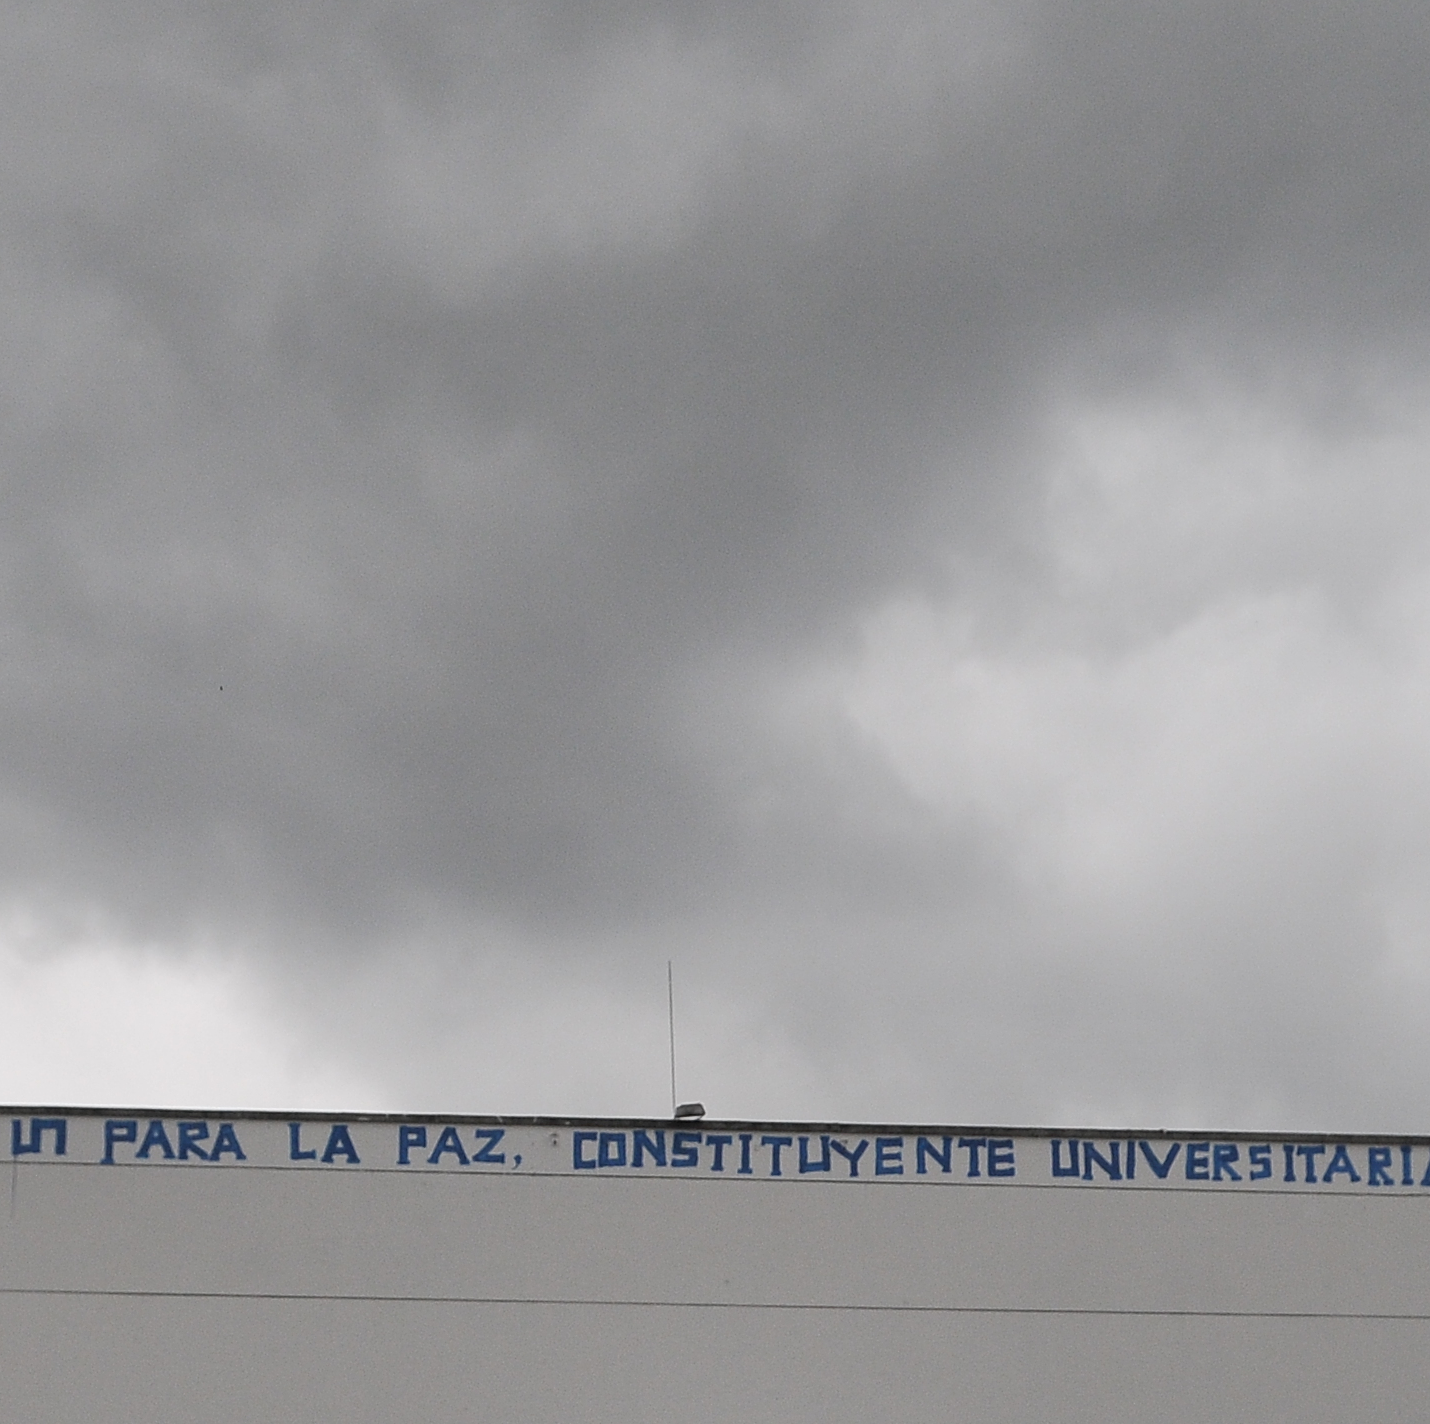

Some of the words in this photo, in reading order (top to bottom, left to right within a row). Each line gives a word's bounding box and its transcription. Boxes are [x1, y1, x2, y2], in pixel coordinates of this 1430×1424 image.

[99, 1119, 248, 1166] PARA
[288, 1122, 362, 1165] LA
[396, 1124, 524, 1169] PAZ,
[571, 1129, 1017, 1179] CONSTITUYENTE
